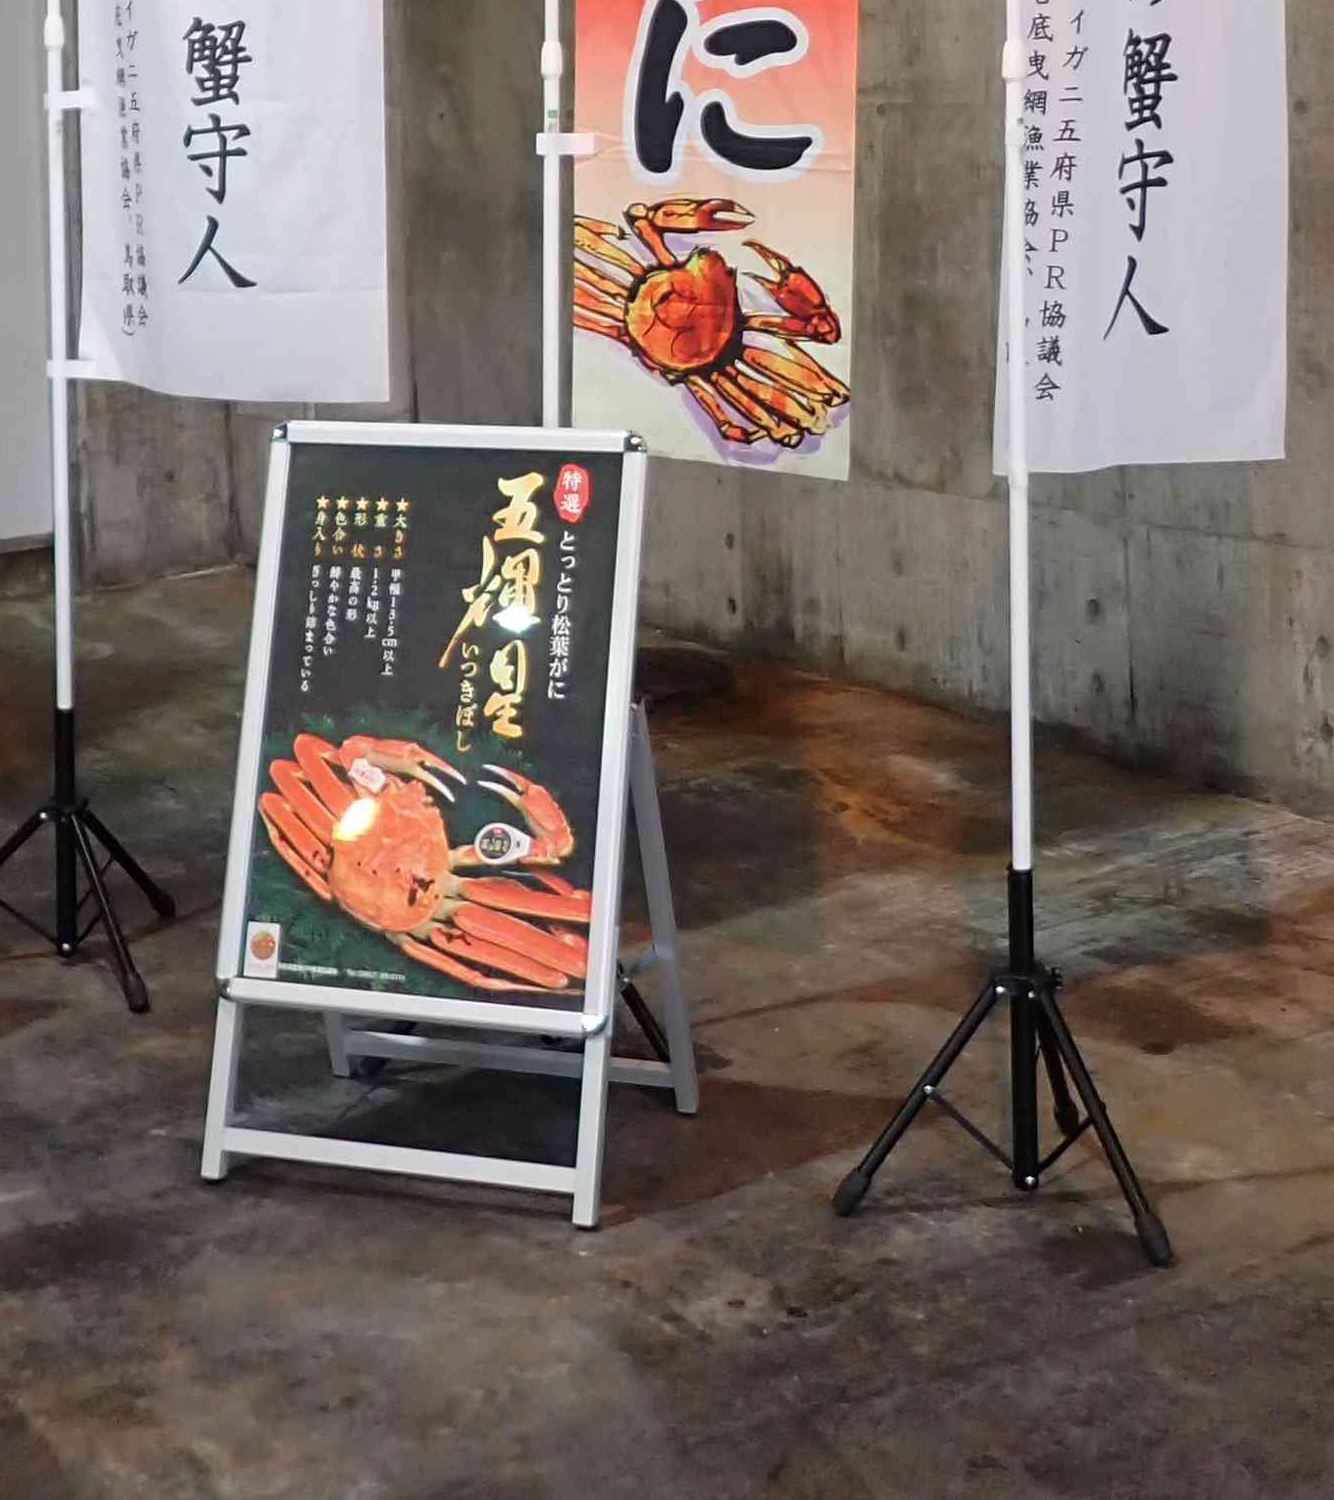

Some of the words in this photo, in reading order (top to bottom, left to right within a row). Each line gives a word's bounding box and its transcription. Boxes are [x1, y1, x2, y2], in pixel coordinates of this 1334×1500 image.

[560, 470, 583, 515] 特選
[438, 472, 547, 738] 五輝星
[547, 530, 577, 700] とっとり松葉がに
[456, 642, 480, 752] いつきぼし
